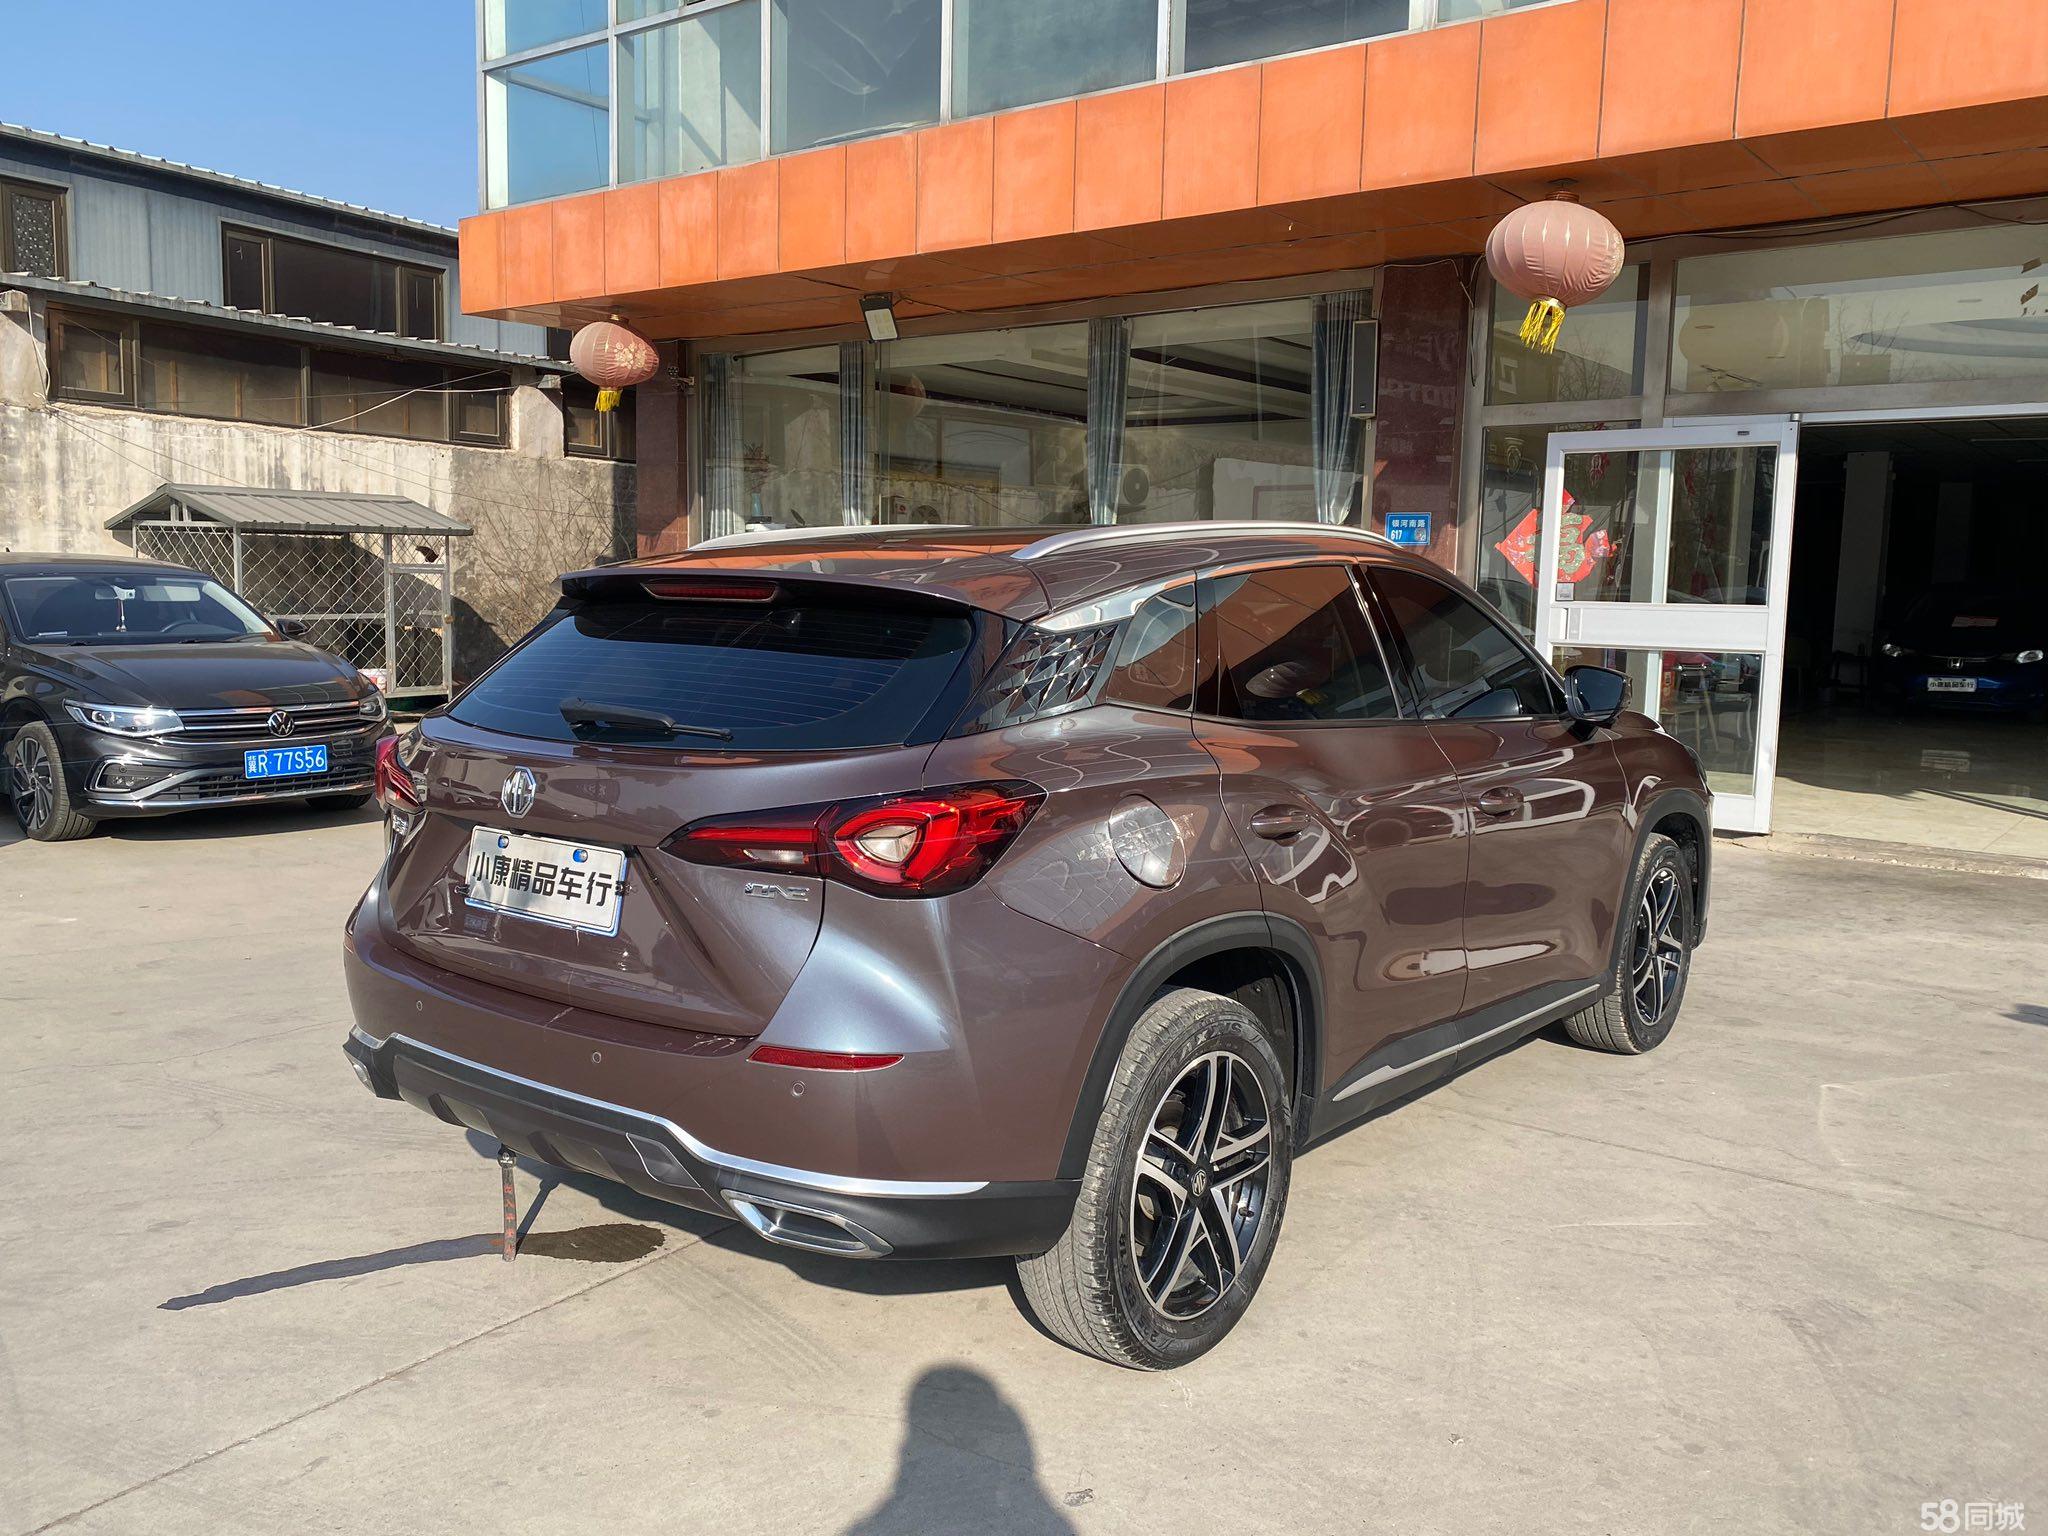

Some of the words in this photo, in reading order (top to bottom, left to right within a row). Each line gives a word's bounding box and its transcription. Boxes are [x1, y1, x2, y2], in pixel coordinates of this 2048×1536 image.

[1392, 519, 1426, 528] 银河南路
[1391, 529, 1403, 540] 617
[472, 851, 613, 907] 小康精品车行
